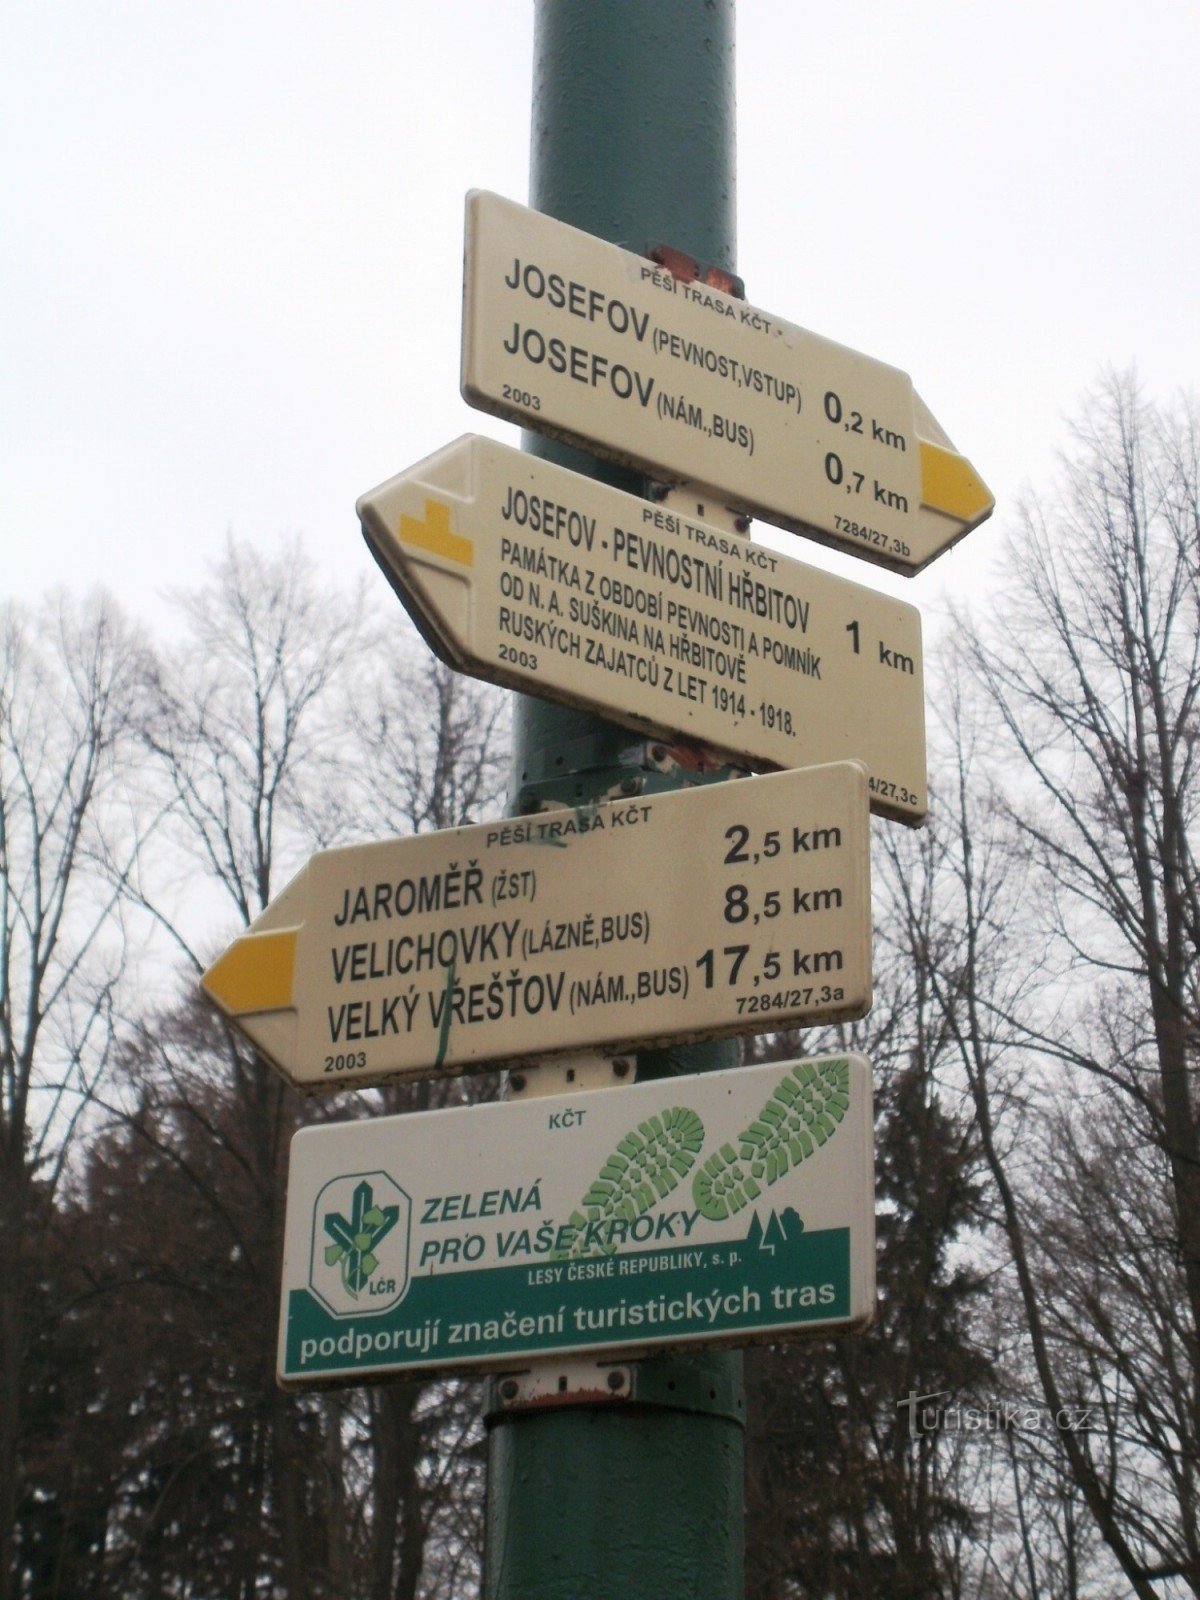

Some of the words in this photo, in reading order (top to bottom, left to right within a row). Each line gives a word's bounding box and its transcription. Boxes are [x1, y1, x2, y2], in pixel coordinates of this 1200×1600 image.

[683, 286, 736, 320] TRASA
[740, 308, 772, 334] KČT
[504, 258, 650, 342] JOSEFOV
[652, 328, 802, 414] (PEVNOST,VSTUP)
[823, 391, 864, 433] 0,2
[872, 419, 906, 451] km
[502, 384, 541, 411] 2003
[503, 323, 655, 408] JOSEFOV
[657, 391, 754, 456] (NÁM.,BUS)
[825, 452, 865, 494] 0,7
[874, 480, 909, 513] km
[642, 508, 681, 535] PĚŠÍ
[685, 524, 741, 560] TRASA
[746, 551, 779, 573] KČT
[834, 515, 911, 557] 7284/27,3b
[501, 486, 597, 552] JOSEFOV
[613, 527, 723, 602] PEVNOSTNÍ
[728, 569, 810, 633] HŘBITOV
[846, 620, 860, 654] 1
[879, 641, 914, 675] km
[500, 571, 524, 601] OD
[529, 581, 544, 609] N.
[548, 590, 564, 617] A.
[569, 597, 639, 645] SUŠKINA
[643, 624, 665, 655] NA
[669, 633, 746, 685] HŘBITOVĚ
[501, 537, 581, 591] PAMÁTKA
[585, 569, 595, 596] Z
[599, 575, 663, 620] OBDOBÍ
[667, 600, 745, 651] PEVNOSTI
[748, 632, 759, 657] A
[763, 637, 822, 680] POMNÍK
[498, 644, 538, 671] 2003
[499, 606, 581, 659] RUSKÝCH
[584, 638, 659, 687] ZAJATCŮ
[663, 667, 673, 692] Z
[678, 671, 707, 704] LET
[712, 684, 745, 718] 1914
[486, 828, 532, 848] PĚŠÍ
[538, 815, 605, 840] TRASA
[611, 803, 652, 827] KČT
[334, 859, 484, 926] JAROMĚŘ
[491, 869, 536, 907] (ŽST)
[723, 824, 781, 865] 2,5
[793, 826, 842, 854] km
[331, 919, 521, 984] VELICHOVKY
[521, 911, 650, 961] (LÁZNĚ,BUS)
[723, 884, 781, 925] 8,5
[793, 886, 843, 914] km
[328, 984, 420, 1043] VELKÝ
[428, 968, 566, 1029] VŘEŠŤOV
[570, 965, 689, 1015] (NÁM.,BUS)
[695, 944, 781, 989] 17,5
[793, 948, 844, 977] km
[736, 985, 845, 1015] 7284/27,3a
[324, 1052, 367, 1073] 2003
[549, 1109, 586, 1130] KČT
[420, 1178, 542, 1224] ZELENÁ
[496, 1219, 577, 1258] VAŠE
[583, 1209, 701, 1248] KROKY
[369, 1278, 396, 1296] LČR
[527, 1268, 563, 1286] LESY
[567, 1258, 614, 1282] ČESKÉ
[619, 1251, 708, 1275] REPUBLIKY,
[712, 1254, 724, 1265] s.
[729, 1251, 742, 1266] p.
[300, 1319, 442, 1364] podporují
[448, 1306, 566, 1344] značení
[573, 1285, 761, 1331] turistických
[771, 1282, 836, 1311] tras
